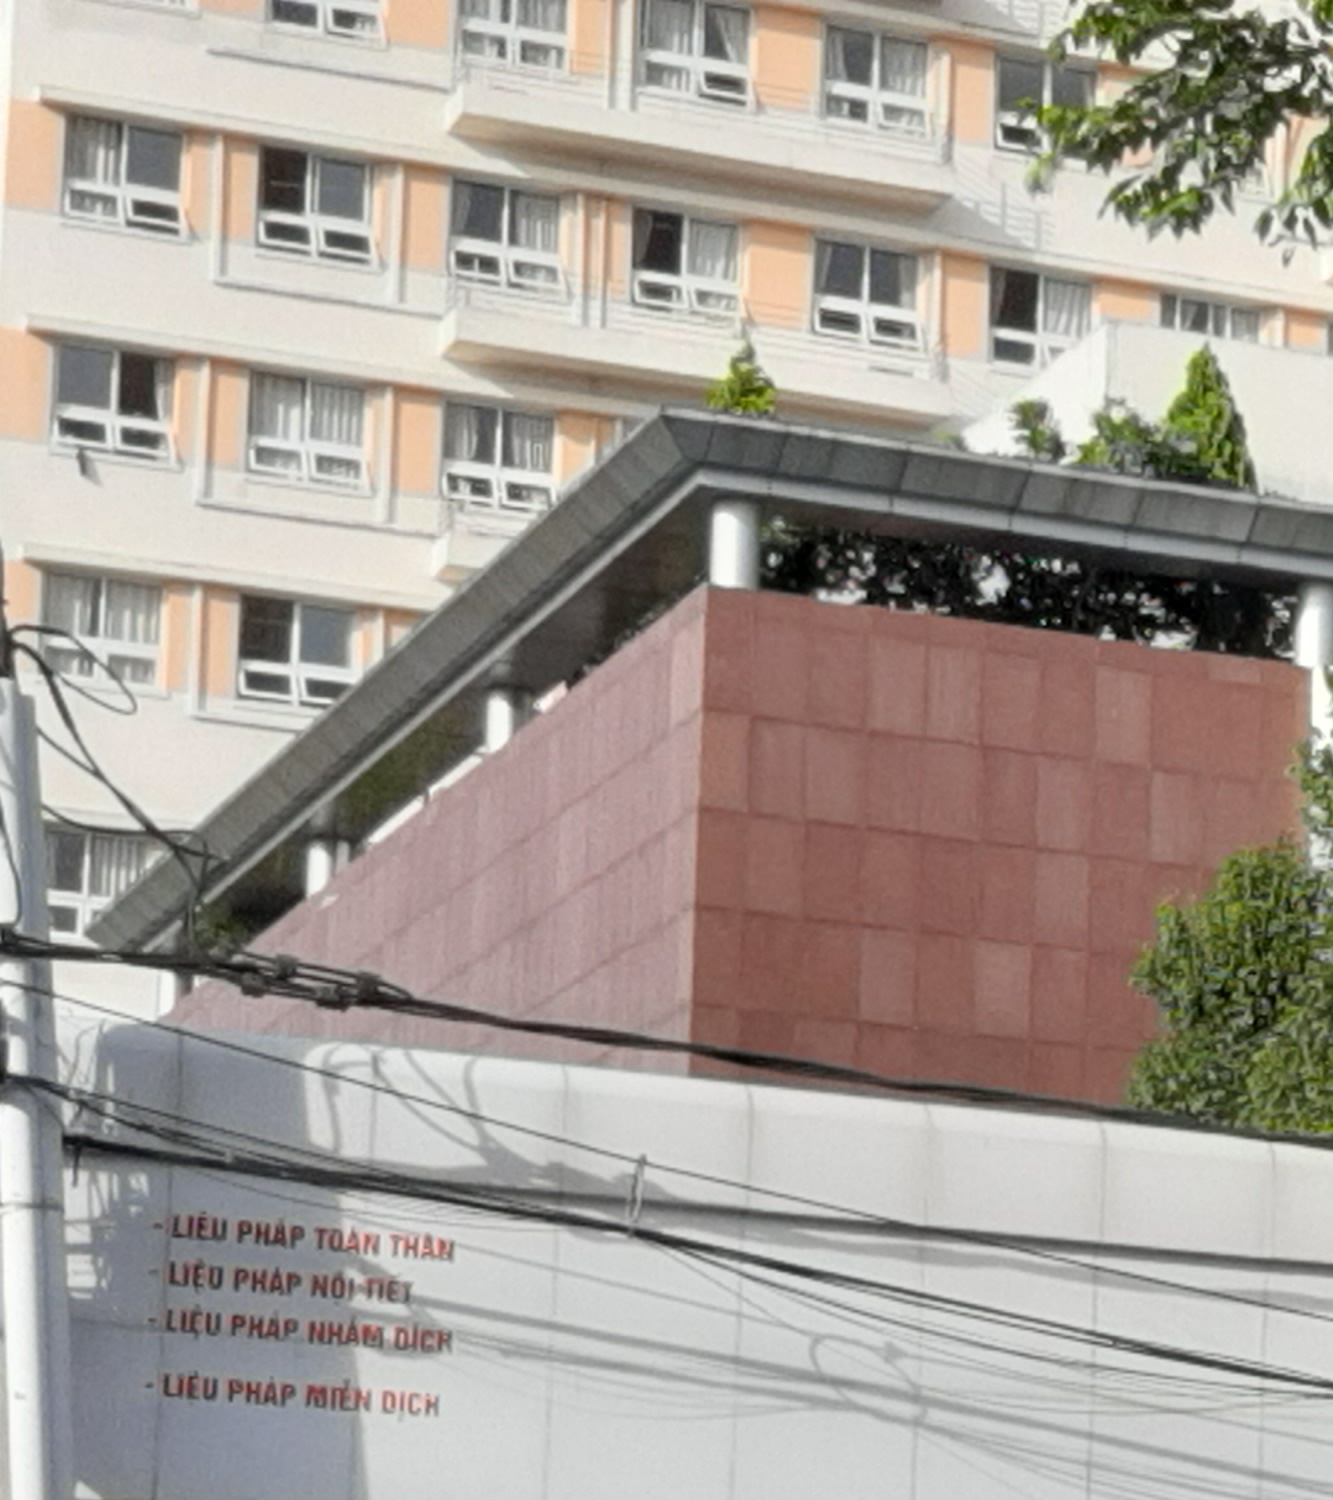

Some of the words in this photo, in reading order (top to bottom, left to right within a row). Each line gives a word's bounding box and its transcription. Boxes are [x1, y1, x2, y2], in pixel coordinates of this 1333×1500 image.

[236, 1217, 305, 1249] PHÁP
[232, 1266, 302, 1298] PHÁP
[230, 1310, 299, 1342] PHÁP
[228, 1377, 297, 1408] PHÁP
